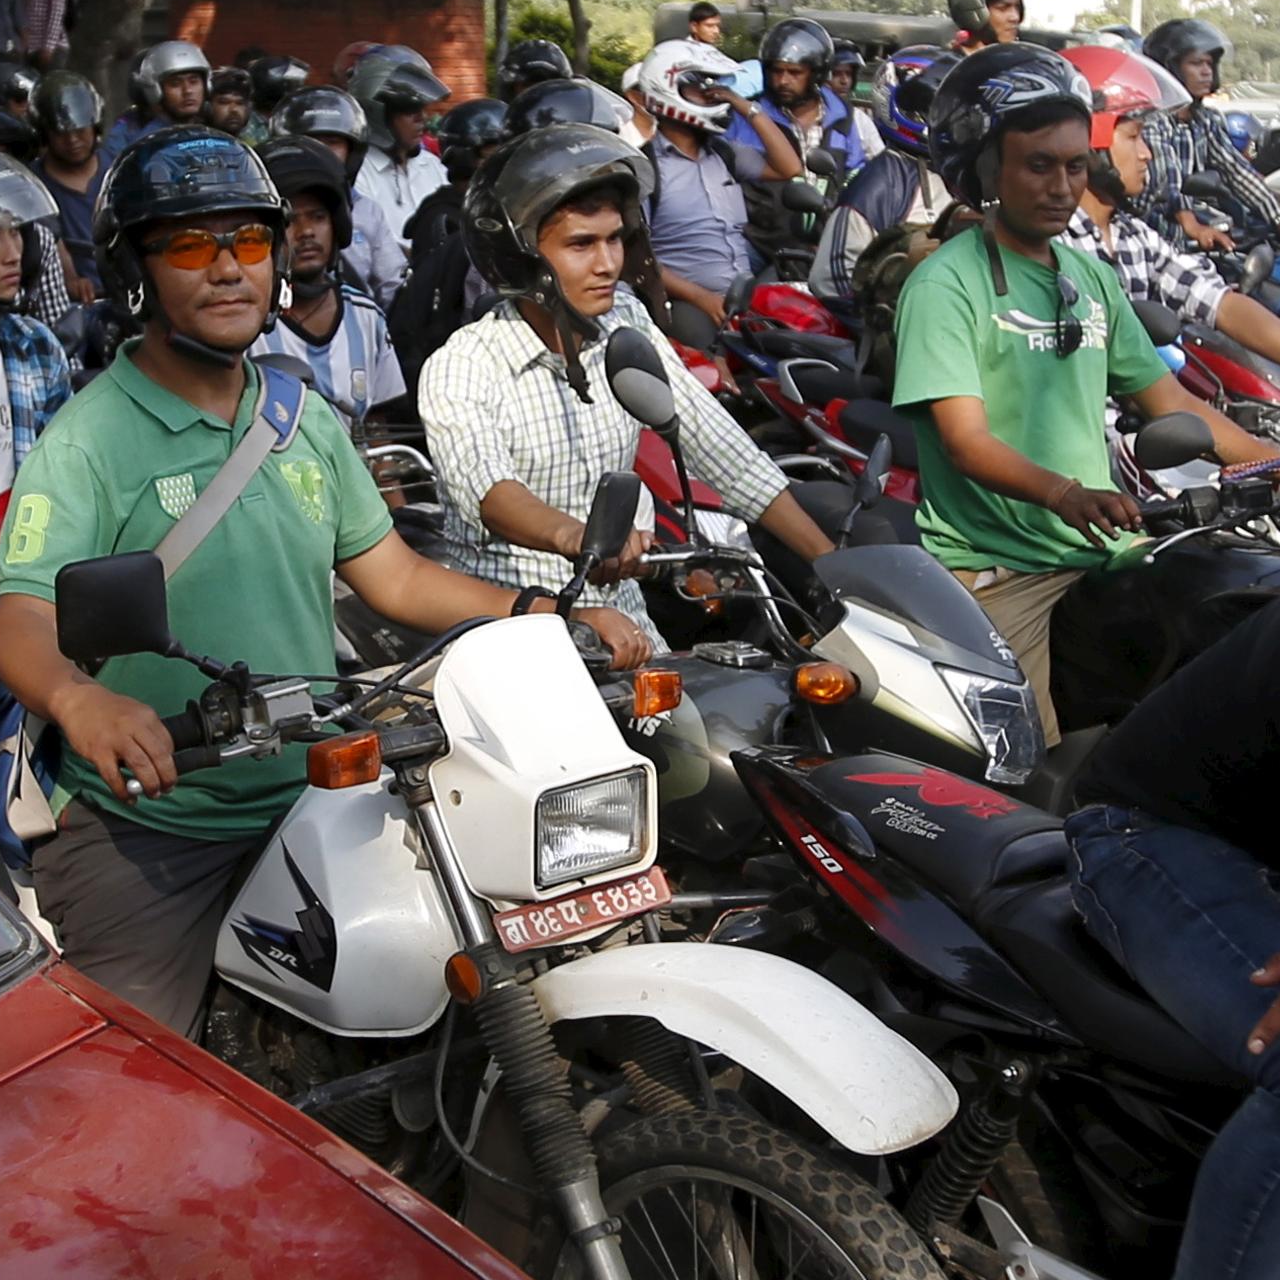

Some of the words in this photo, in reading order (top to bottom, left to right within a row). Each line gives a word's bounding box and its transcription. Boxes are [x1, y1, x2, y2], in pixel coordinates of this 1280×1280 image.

[4, 493, 51, 564] B
[800, 834, 843, 873] 150
[501, 915, 531, 945] बा
[268, 945, 298, 968] DR
